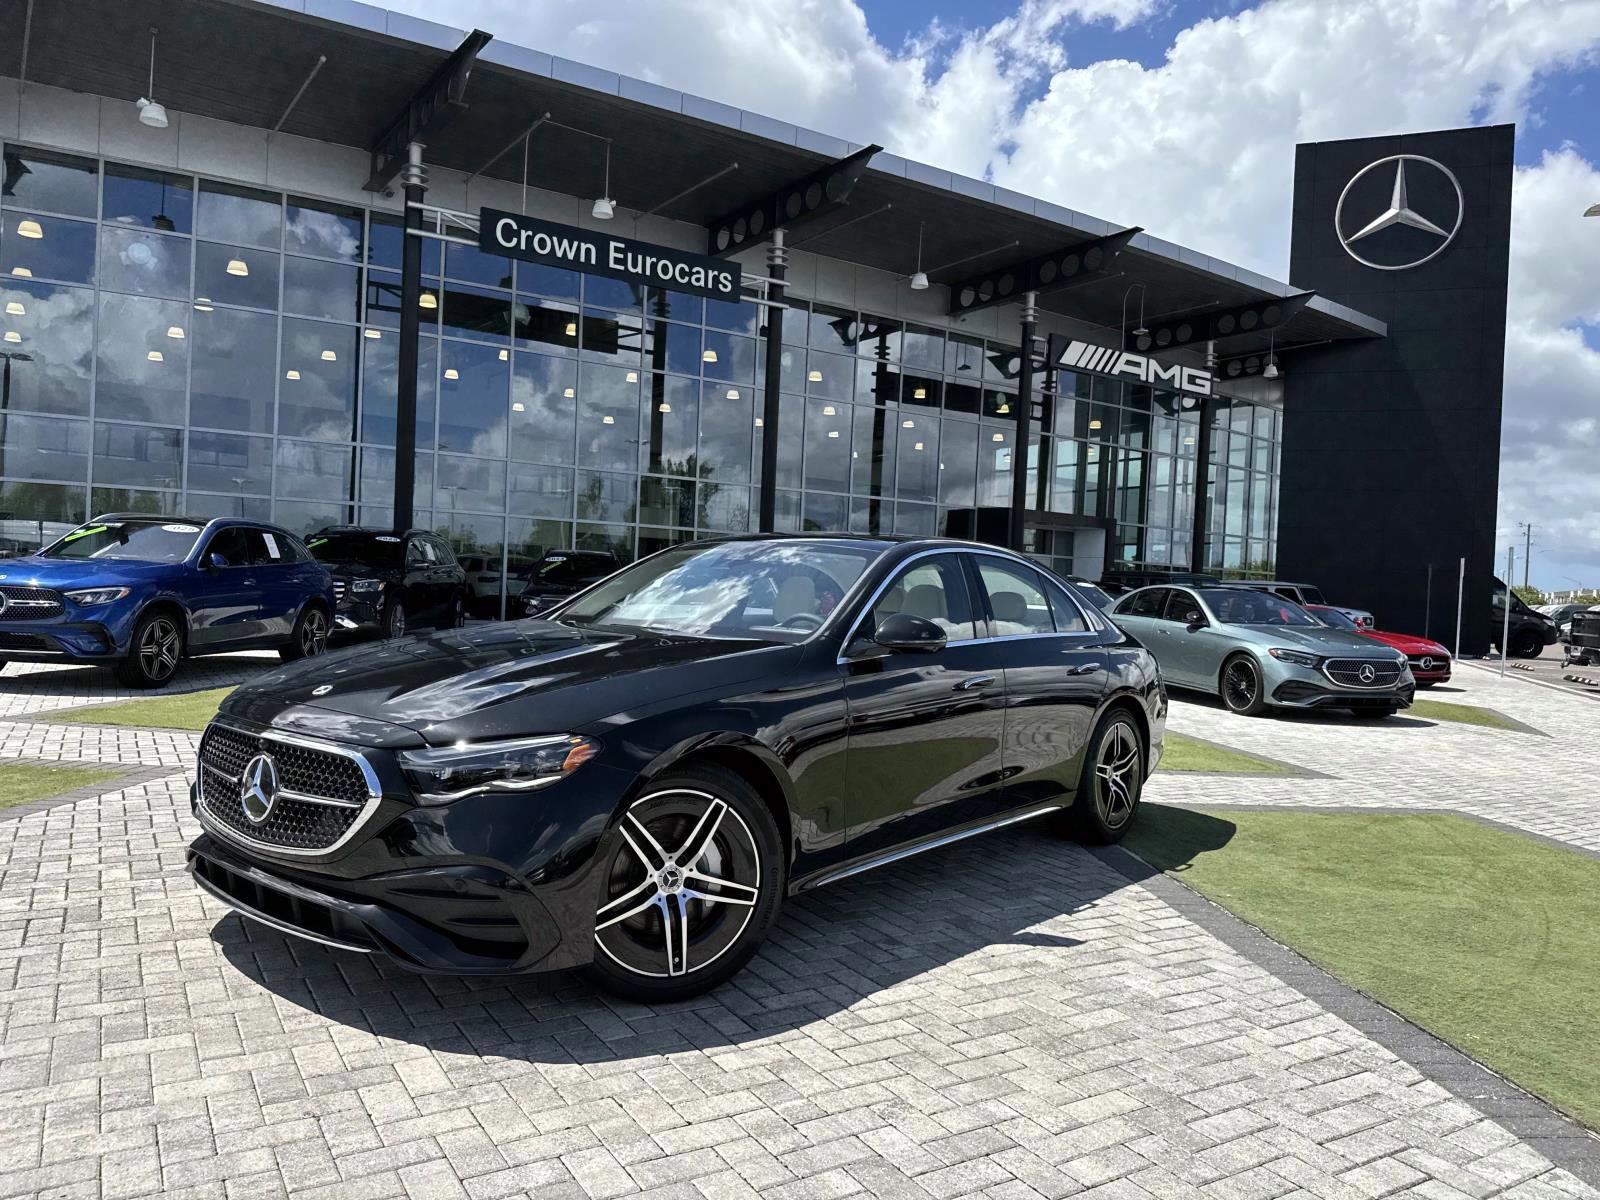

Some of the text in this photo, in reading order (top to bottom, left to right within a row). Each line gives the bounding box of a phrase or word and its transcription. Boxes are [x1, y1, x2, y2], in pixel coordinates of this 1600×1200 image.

[495, 218, 733, 293] Crown Eurocars
[1111, 352, 1212, 395] AMG
